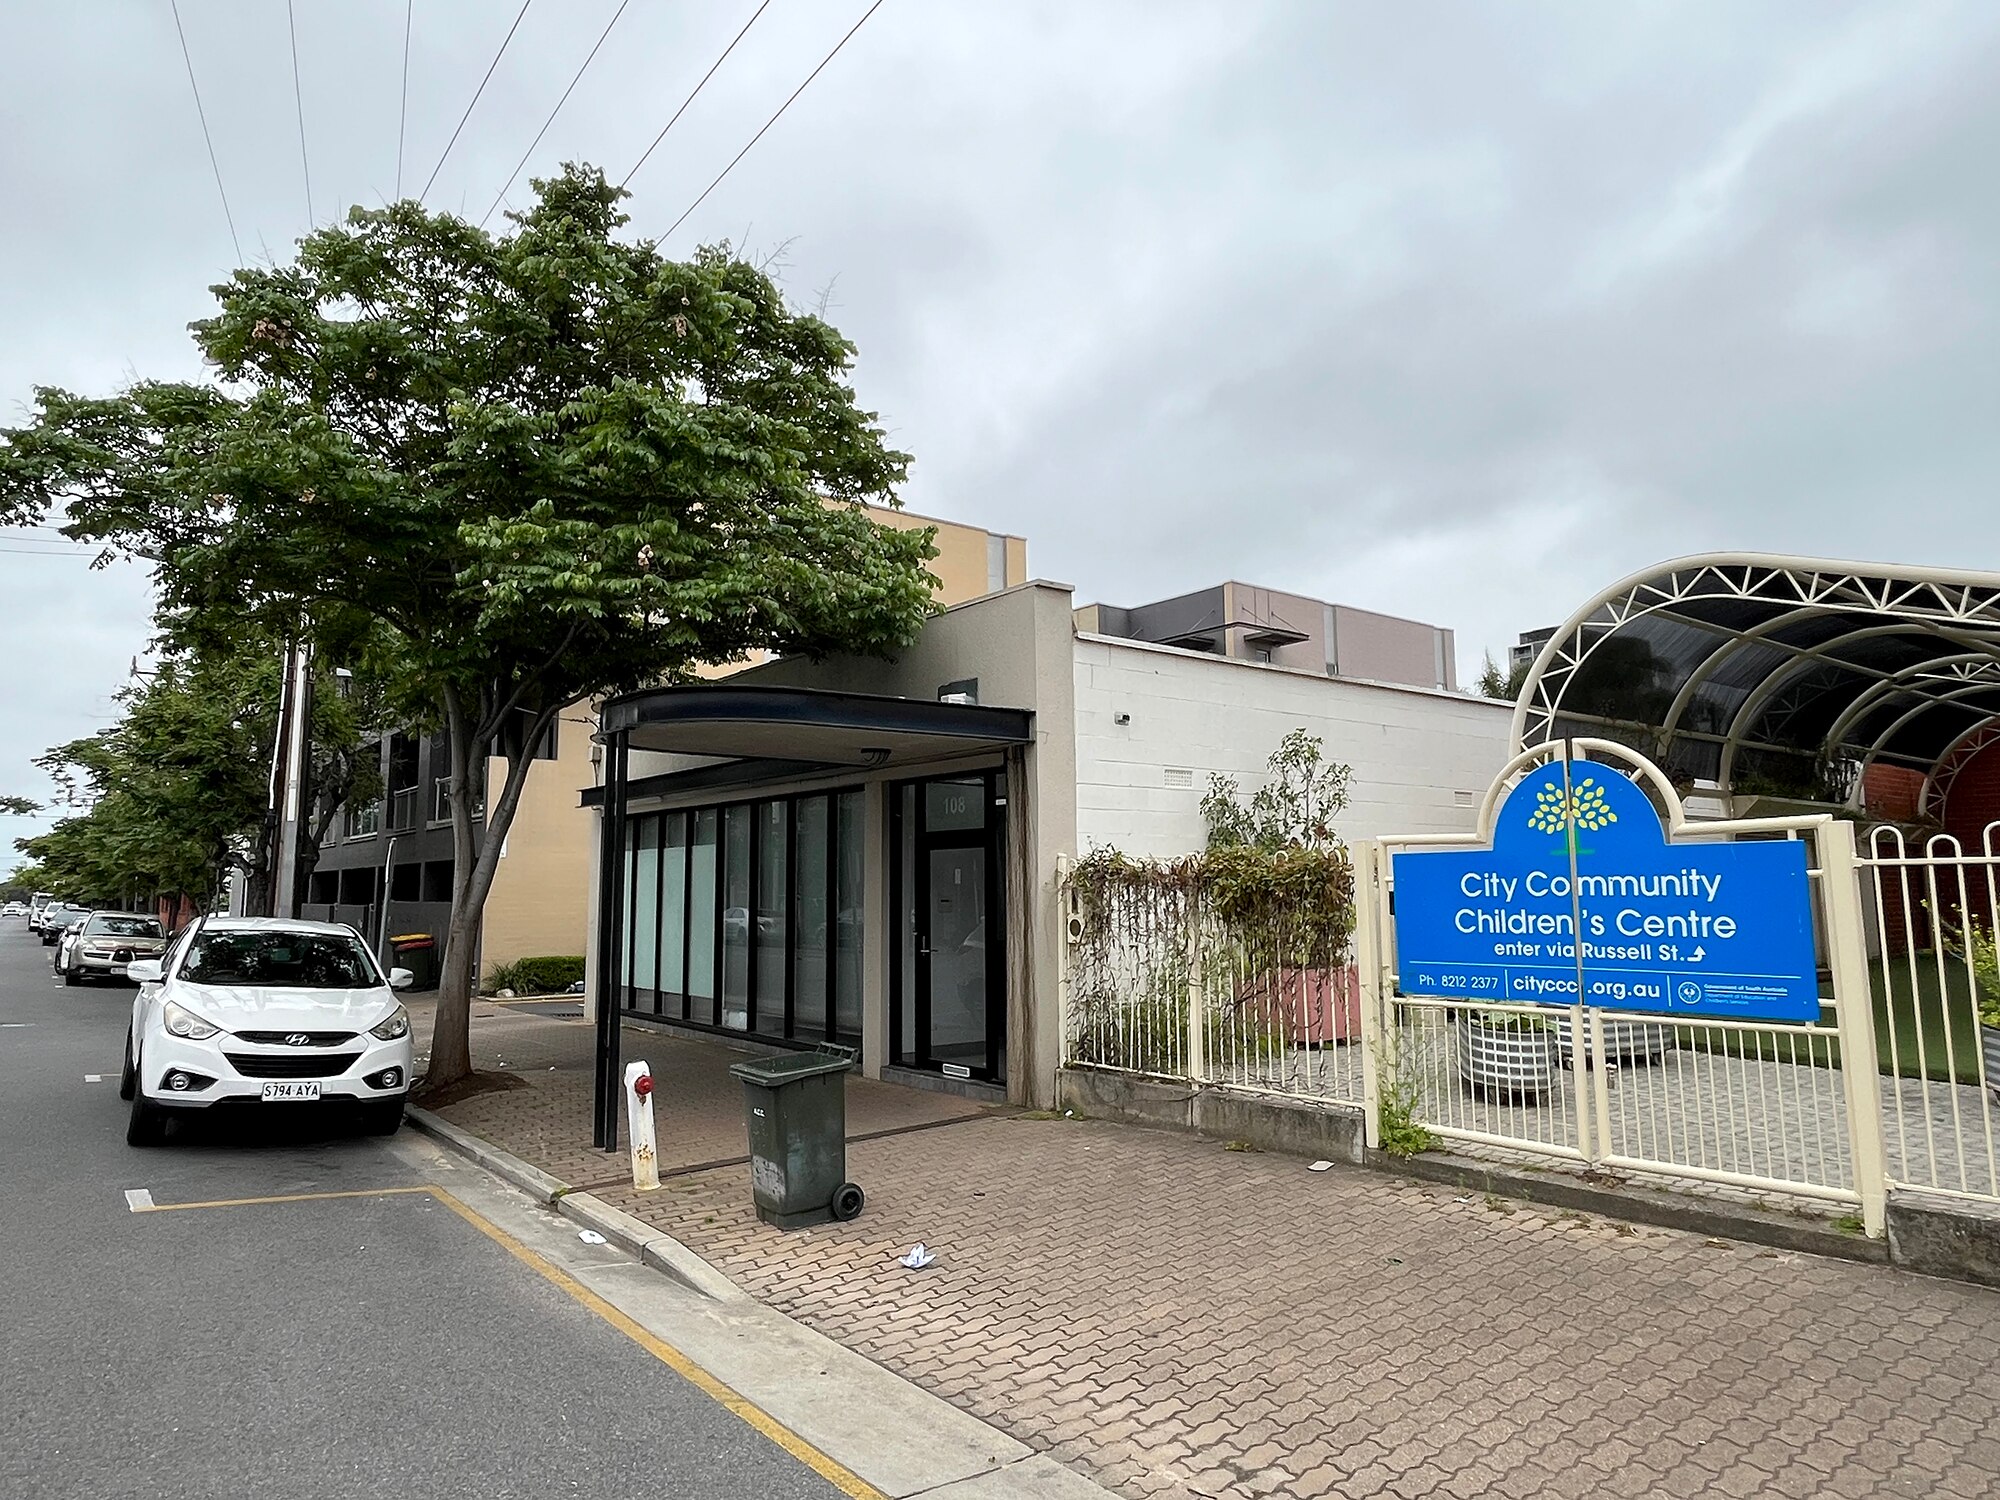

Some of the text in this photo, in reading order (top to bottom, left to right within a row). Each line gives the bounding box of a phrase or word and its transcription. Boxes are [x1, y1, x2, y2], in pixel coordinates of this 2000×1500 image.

[944, 796, 966, 815] 108
[1460, 869, 1722, 902] City Community
[1454, 908, 1737, 938] Children's Centre
[1494, 941, 1685, 961] enter via Russell St.
[1419, 974, 1498, 989] Ph. 8212 2377
[264, 1085, 318, 1097] S794 AYA
